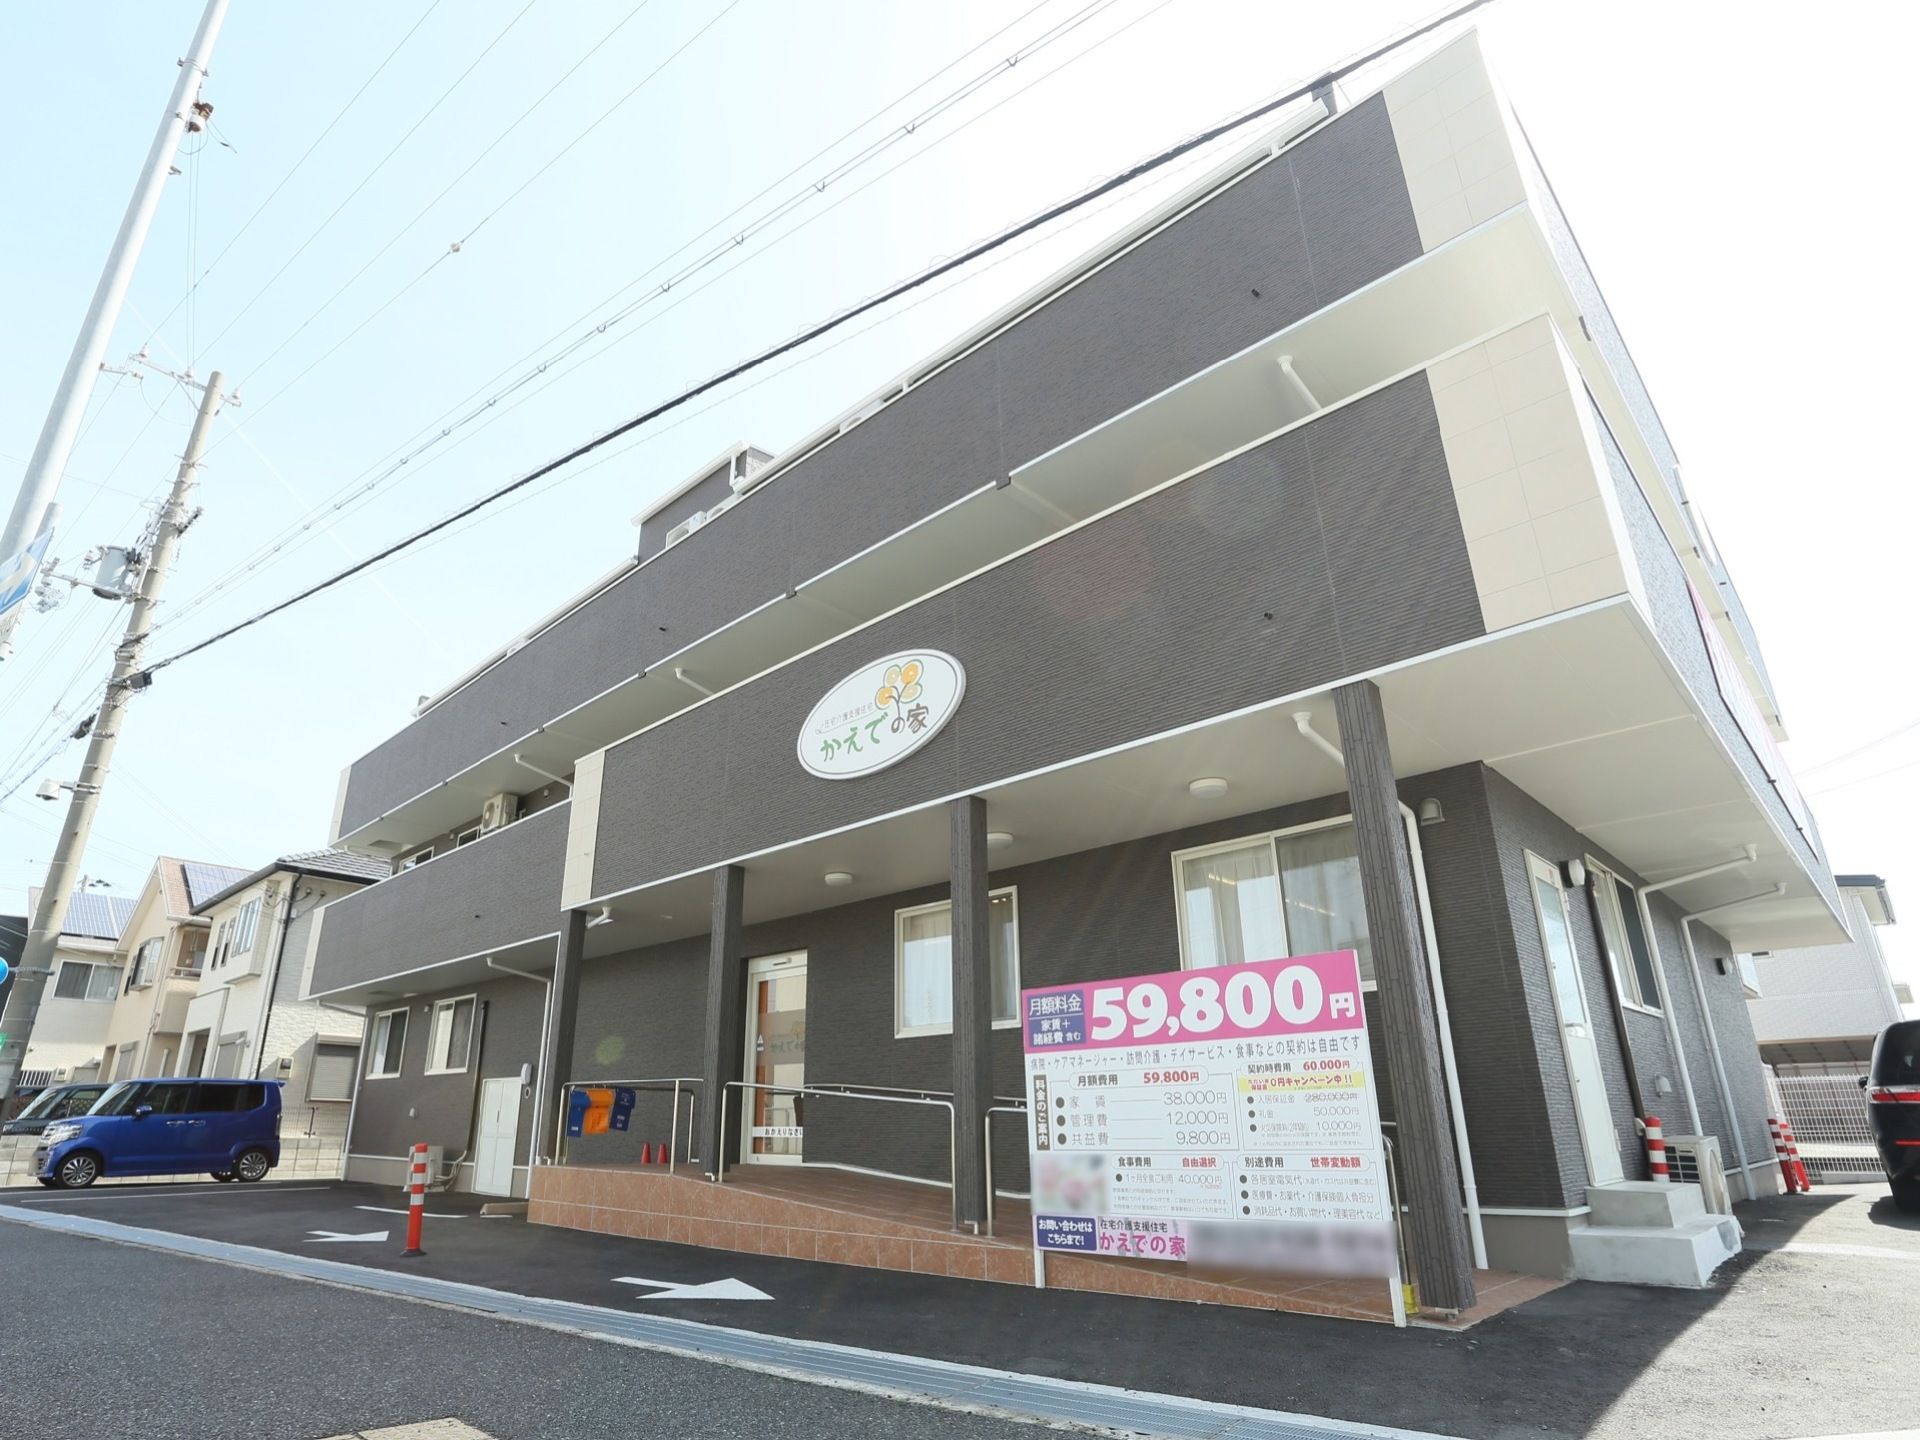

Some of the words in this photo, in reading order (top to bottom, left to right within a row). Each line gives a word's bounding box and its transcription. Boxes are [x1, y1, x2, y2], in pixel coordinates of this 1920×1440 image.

[820, 703, 929, 762] かえでの家
[1029, 993, 1082, 1016] 月額料金
[1091, 964, 1356, 1041] 59,800円
[1077, 1074, 1118, 1087] 月額費用
[1163, 1090, 1227, 1106] 38,000円
[1167, 1110, 1229, 1126] 12,000円
[1176, 1130, 1231, 1146] 9,800円
[1118, 1156, 1152, 1168] 食事費用
[1182, 1156, 1217, 1168] 自由選択
[1244, 1156, 1284, 1168] 別途費用
[1038, 1219, 1093, 1232] お問い合わせは
[1100, 1219, 1168, 1232] 在宅介護支援住宅
[1100, 1232, 1186, 1257] かえでの家
